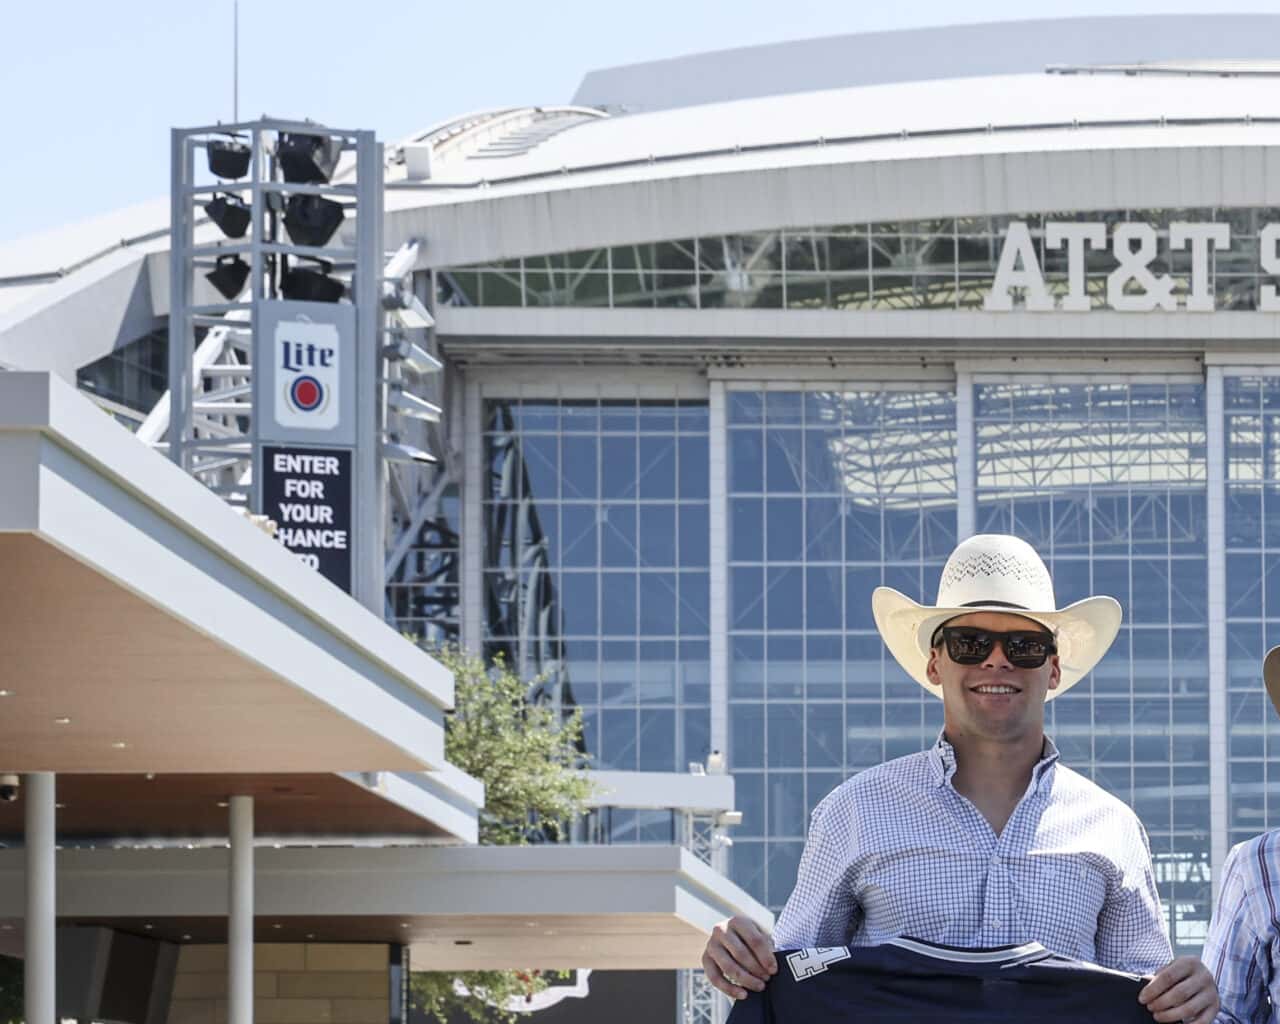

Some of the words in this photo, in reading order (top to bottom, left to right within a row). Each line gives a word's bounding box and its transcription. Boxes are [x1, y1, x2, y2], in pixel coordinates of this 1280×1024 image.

[982, 221, 1230, 312] AT&T
[281, 341, 334, 372] Lite
[273, 453, 340, 475] ENTER
[284, 478, 325, 499] FOR
[279, 503, 334, 524] YOUR
